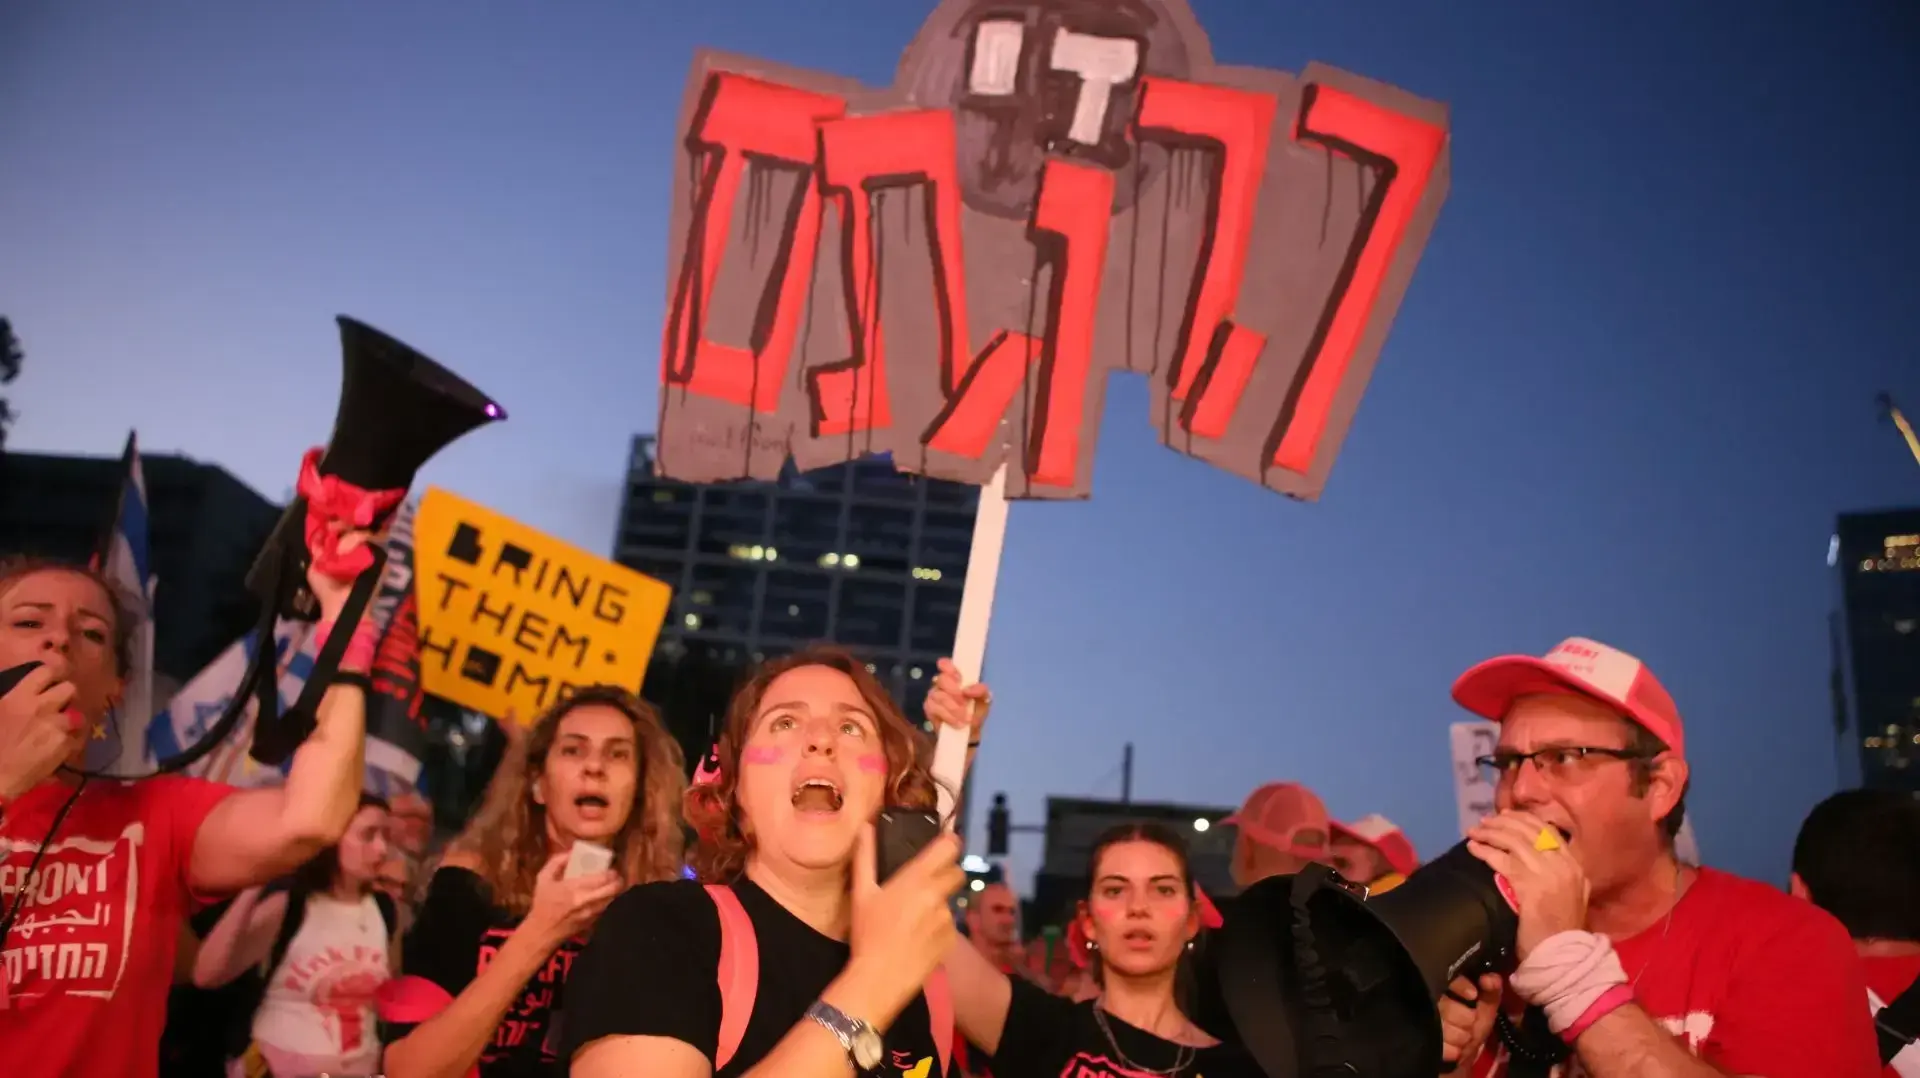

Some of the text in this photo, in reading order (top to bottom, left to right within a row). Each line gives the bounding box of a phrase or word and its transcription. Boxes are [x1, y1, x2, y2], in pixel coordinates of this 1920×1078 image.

[969, 20, 1139, 146] די
[447, 520, 629, 625] BRING
[419, 625, 572, 707] HOM
[0, 855, 107, 908] FRONT
